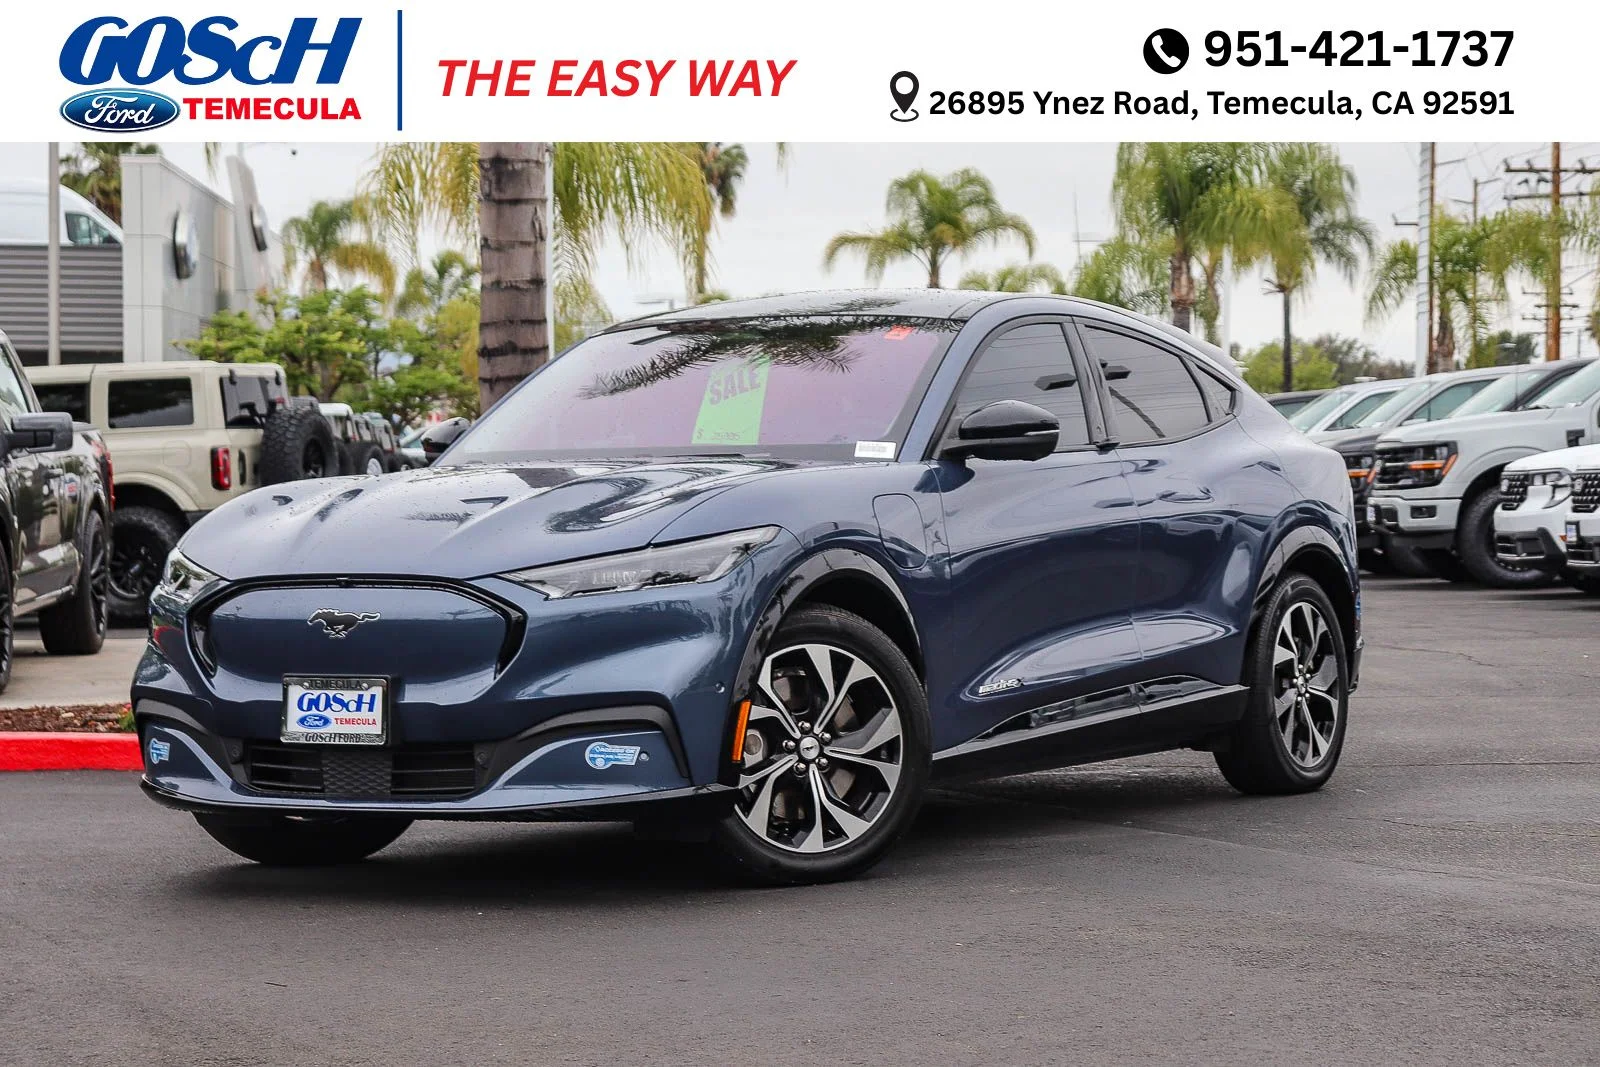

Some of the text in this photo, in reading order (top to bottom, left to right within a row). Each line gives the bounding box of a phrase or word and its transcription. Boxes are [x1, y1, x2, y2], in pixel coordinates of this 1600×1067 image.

[709, 363, 762, 406] SALE
[309, 679, 362, 690] TEMECULA
[303, 715, 377, 727] Ford TEMECULA
[338, 733, 361, 743] FORD
